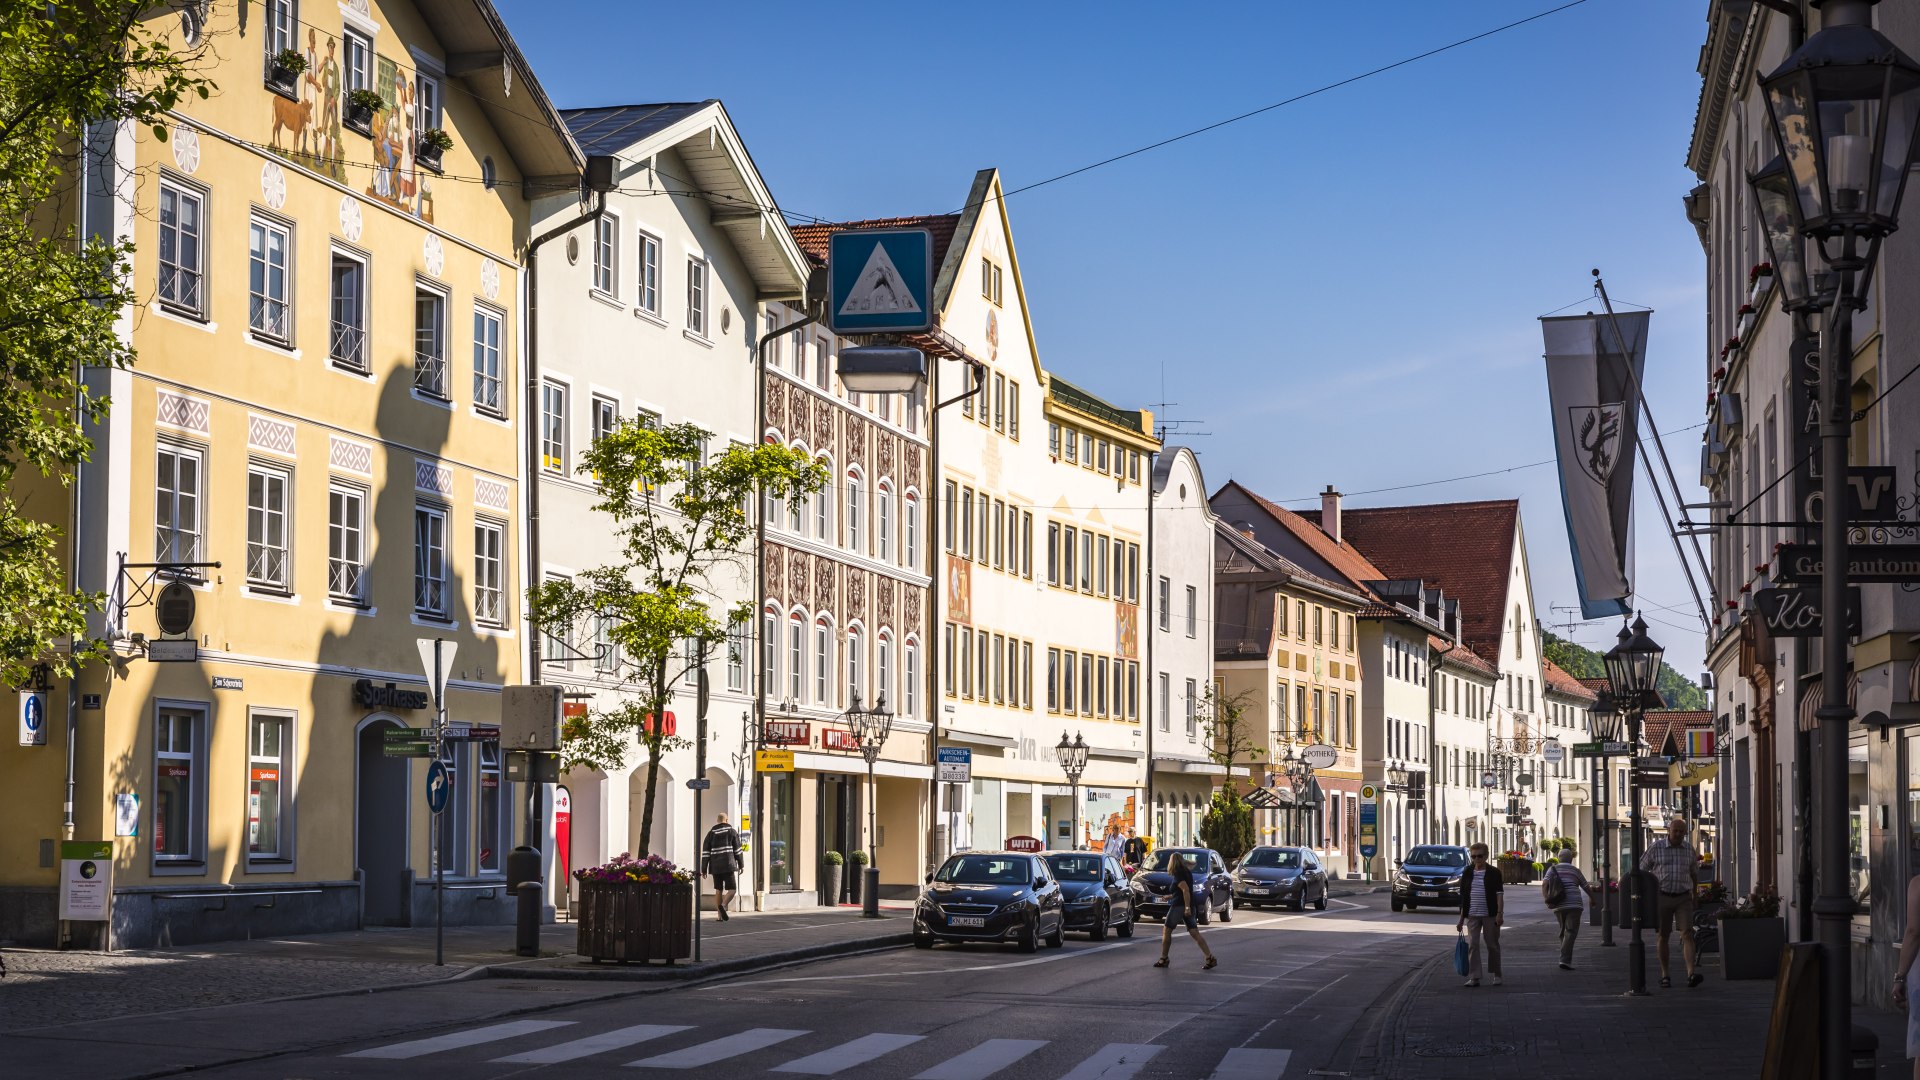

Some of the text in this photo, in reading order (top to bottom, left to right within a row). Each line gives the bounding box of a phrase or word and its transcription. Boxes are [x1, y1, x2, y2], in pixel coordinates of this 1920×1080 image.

[1795, 557, 1920, 575] Geautom
[356, 679, 428, 709] Sparkasse
[768, 724, 808, 738] WITT
[26, 732, 40, 742] ZONE
[826, 731, 841, 749] WITT
[939, 748, 970, 756] PARKSCHEIN-
[1303, 750, 1335, 758] APOTHEKE
[168, 768, 188, 776] Sparkasse
[259, 771, 276, 779] Sparkasse
[1011, 839, 1036, 849] WITT
